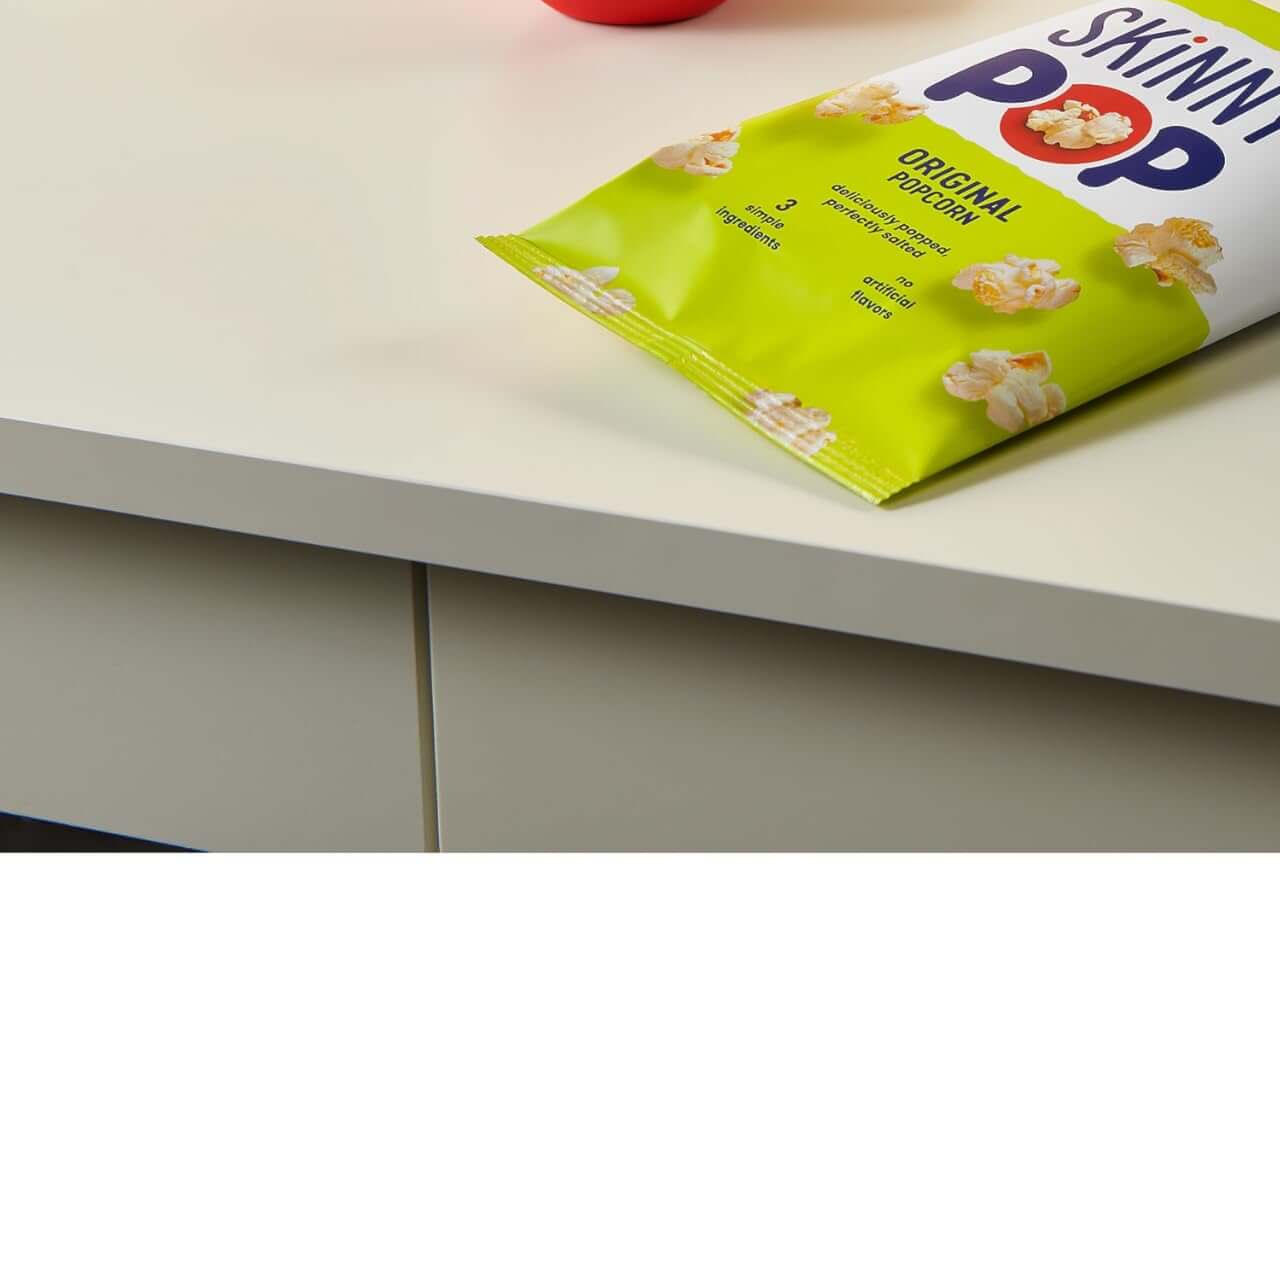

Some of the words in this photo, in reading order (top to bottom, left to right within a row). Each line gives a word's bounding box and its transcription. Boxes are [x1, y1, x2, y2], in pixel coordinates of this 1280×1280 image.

[923, 48, 1225, 191] POP
[775, 199, 797, 212] 3
[888, 171, 979, 226] POPCORN
[898, 148, 1023, 223] ORIGINAL
[716, 206, 781, 251] ingredients
[745, 203, 784, 230] simple
[822, 197, 884, 236] perfectly
[881, 231, 926, 259] salted
[831, 183, 900, 227] deliciously
[894, 219, 950, 257] popped,
[863, 275, 916, 310] artificial
[895, 274, 913, 288] no
[850, 289, 893, 320] flavors
